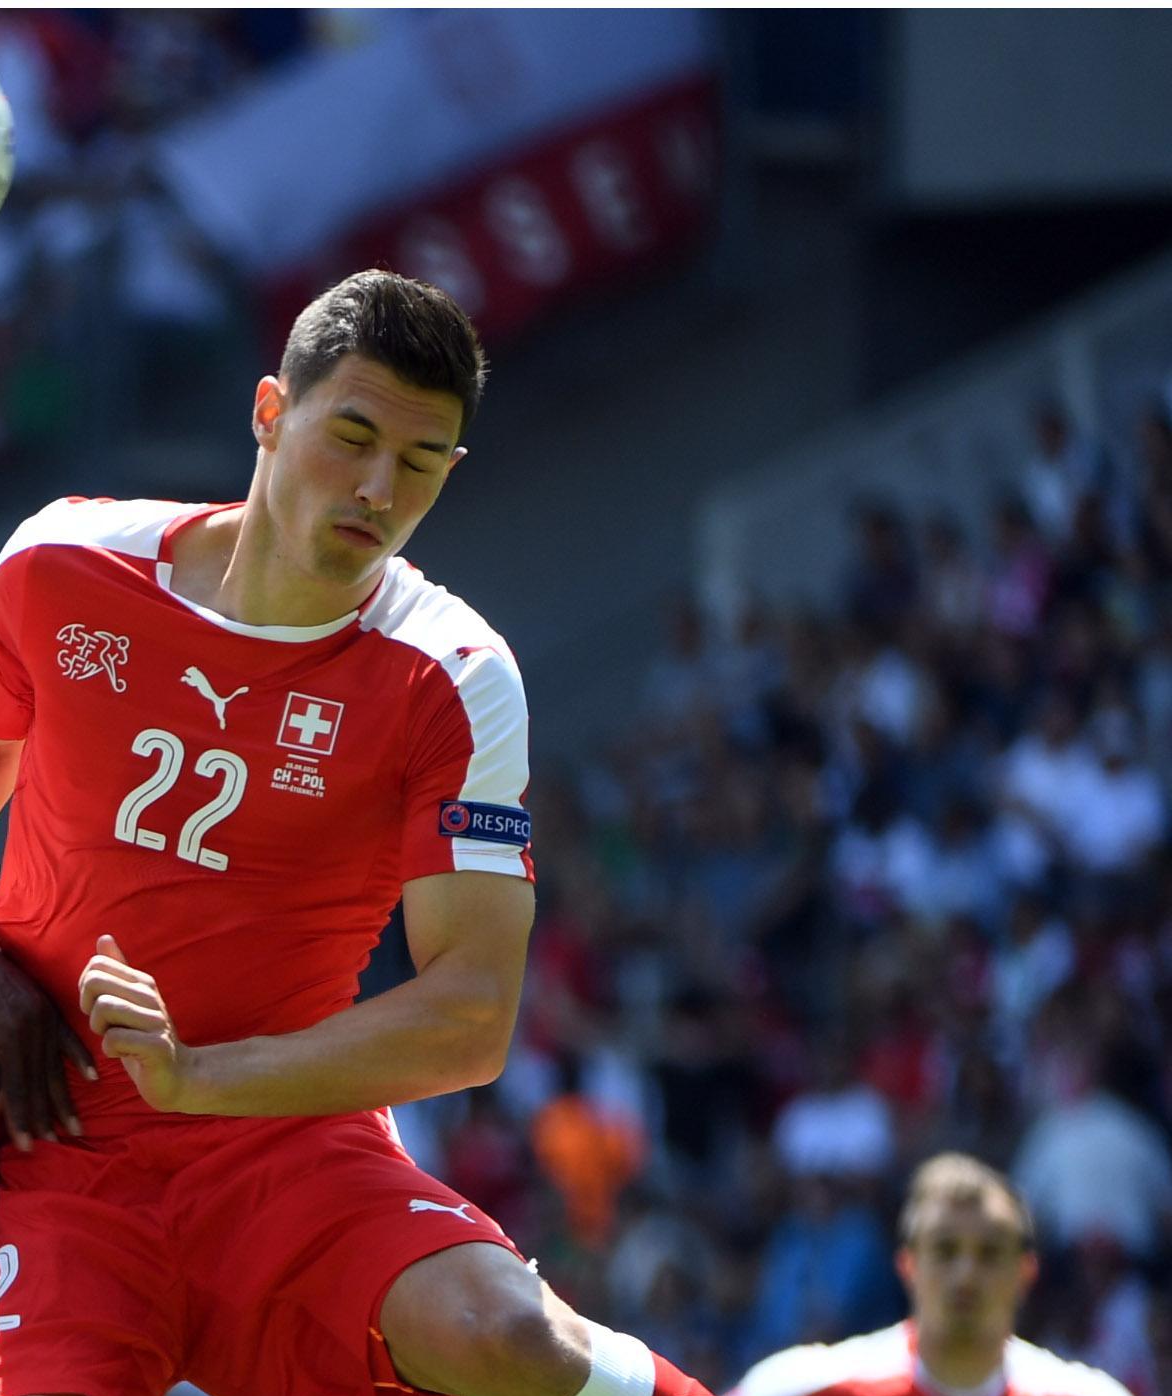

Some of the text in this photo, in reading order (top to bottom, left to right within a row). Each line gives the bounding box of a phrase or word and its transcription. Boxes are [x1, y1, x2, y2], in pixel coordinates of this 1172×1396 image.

[273, 767, 292, 783] CH
[301, 773, 326, 790] POL
[114, 728, 249, 872] 22
[473, 812, 531, 838] RESPEC
